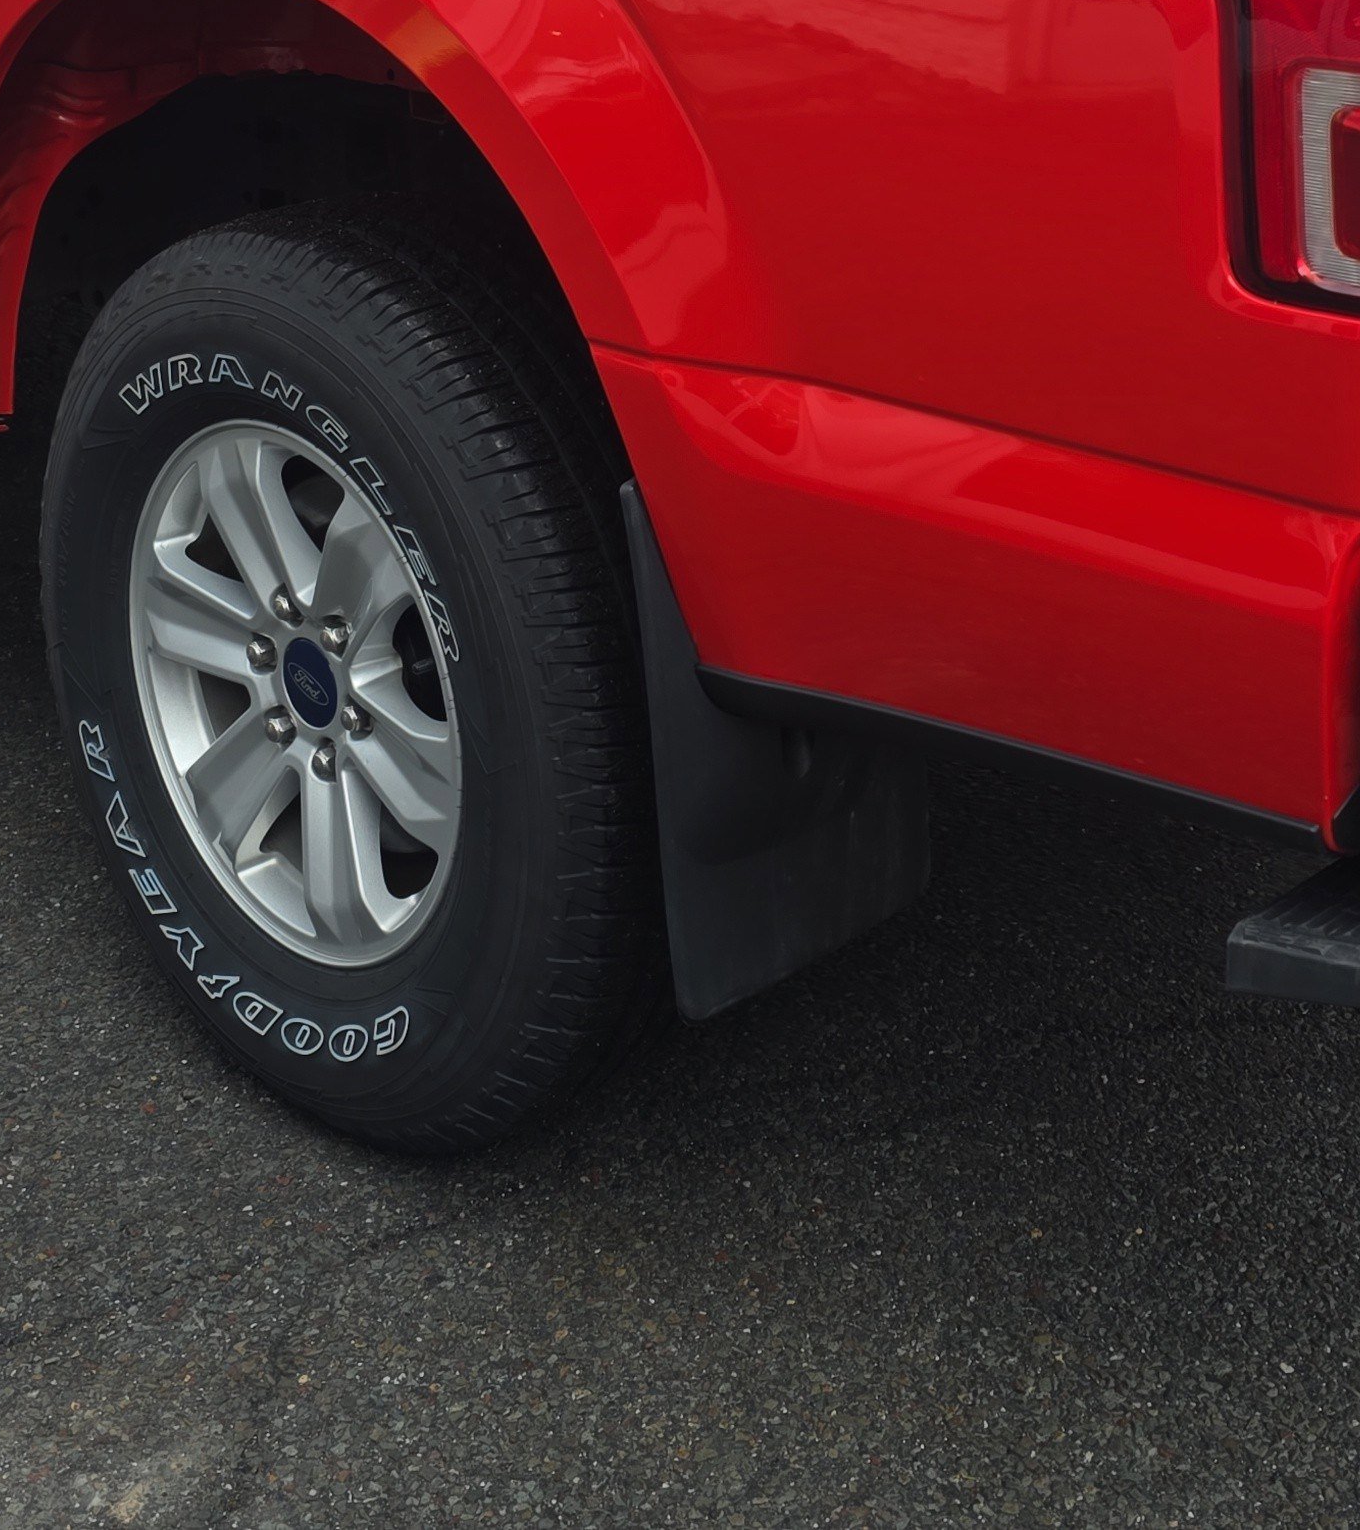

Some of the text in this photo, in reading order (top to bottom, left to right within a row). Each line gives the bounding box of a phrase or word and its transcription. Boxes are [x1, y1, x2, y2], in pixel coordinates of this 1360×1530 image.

[118, 353, 462, 663] WRANGLER
[293, 669, 321, 700] Ford
[77, 718, 411, 1062] GOODYEAR
